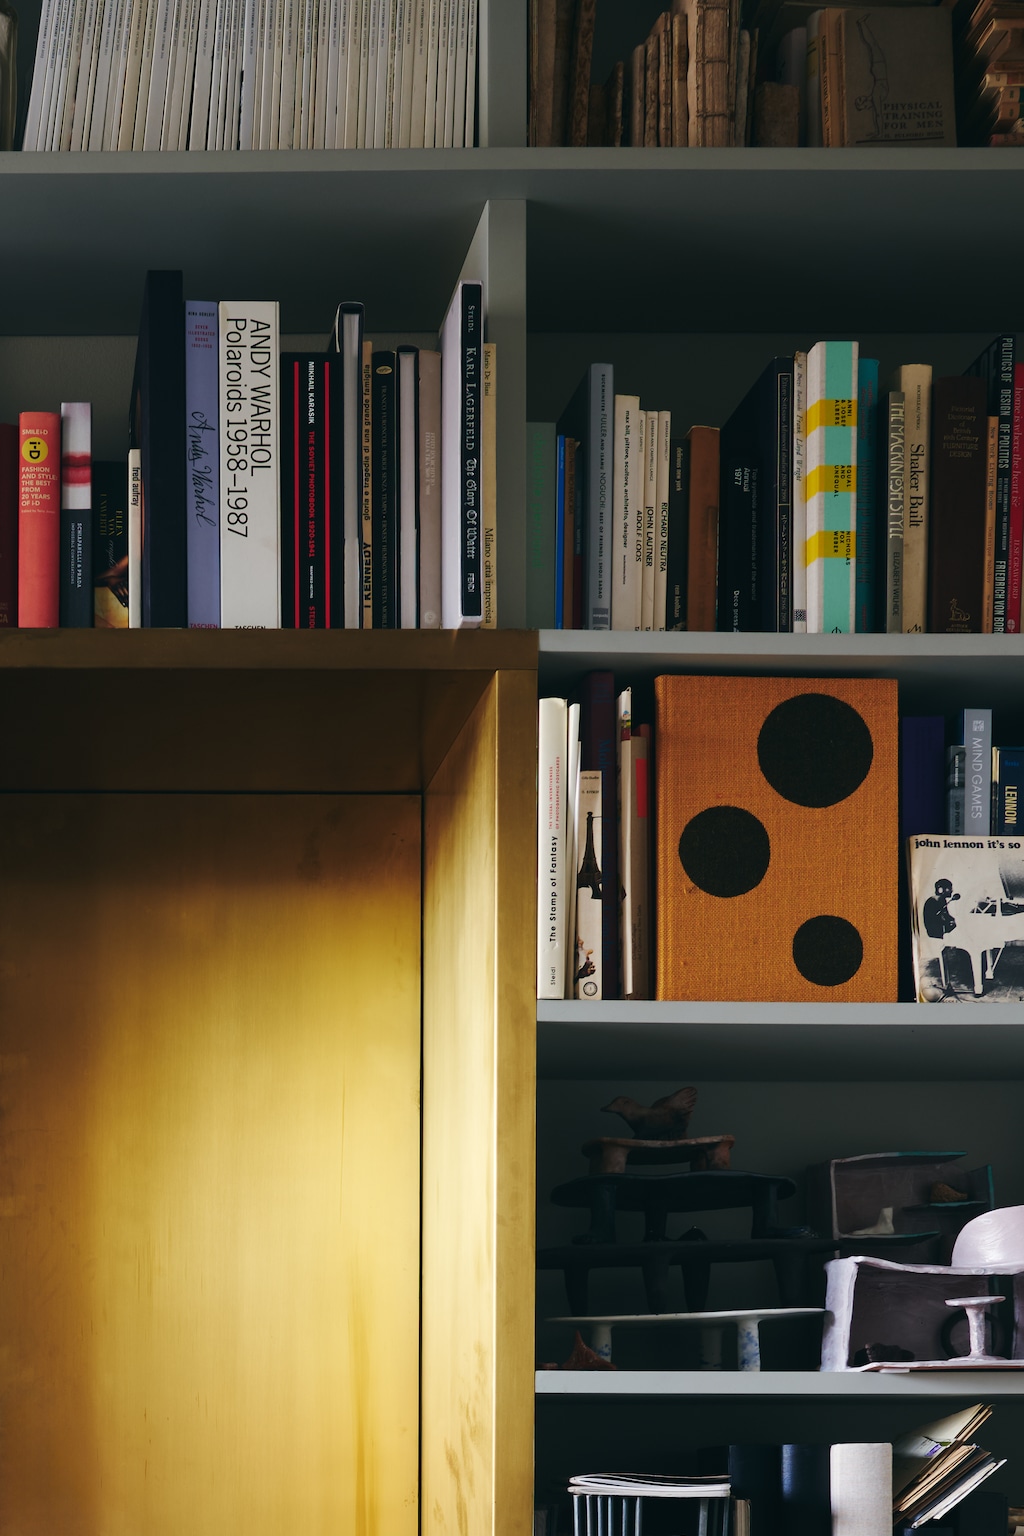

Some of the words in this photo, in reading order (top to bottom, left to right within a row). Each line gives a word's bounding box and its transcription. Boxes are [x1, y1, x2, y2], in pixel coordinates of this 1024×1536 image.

[884, 102, 943, 110] PHYSICAL
[884, 112, 943, 120] TRAINING
[884, 121, 908, 130] FOR
[917, 121, 944, 129] MEN
[226, 318, 248, 412] Polaroids
[250, 320, 271, 378] ANDY
[465, 347, 477, 378] KARL
[1001, 338, 1014, 371] POLITICS
[307, 362, 315, 391] MIKHAIL
[1001, 372, 1012, 383] OF
[307, 392, 315, 424] KARASIK
[465, 383, 477, 450] LAGERFELD
[1000, 389, 1011, 416] DESIGN
[250, 384, 272, 476] WARHOL
[910, 444, 925, 492] Shaker
[645, 506, 653, 529] JOHN
[909, 495, 924, 528] Built
[645, 531, 653, 567] LAUTNER
[659, 540, 667, 572] NEUTRA
[972, 737, 983, 772] MIND
[971, 774, 983, 819] GAMES
[1004, 785, 1017, 824] LENNON
[549, 836, 558, 873] Fantasy
[915, 839, 940, 849] john
[943, 840, 983, 849] lennon
[549, 878, 557, 887] of
[549, 891, 559, 921] Stamp
[549, 925, 557, 942] The
